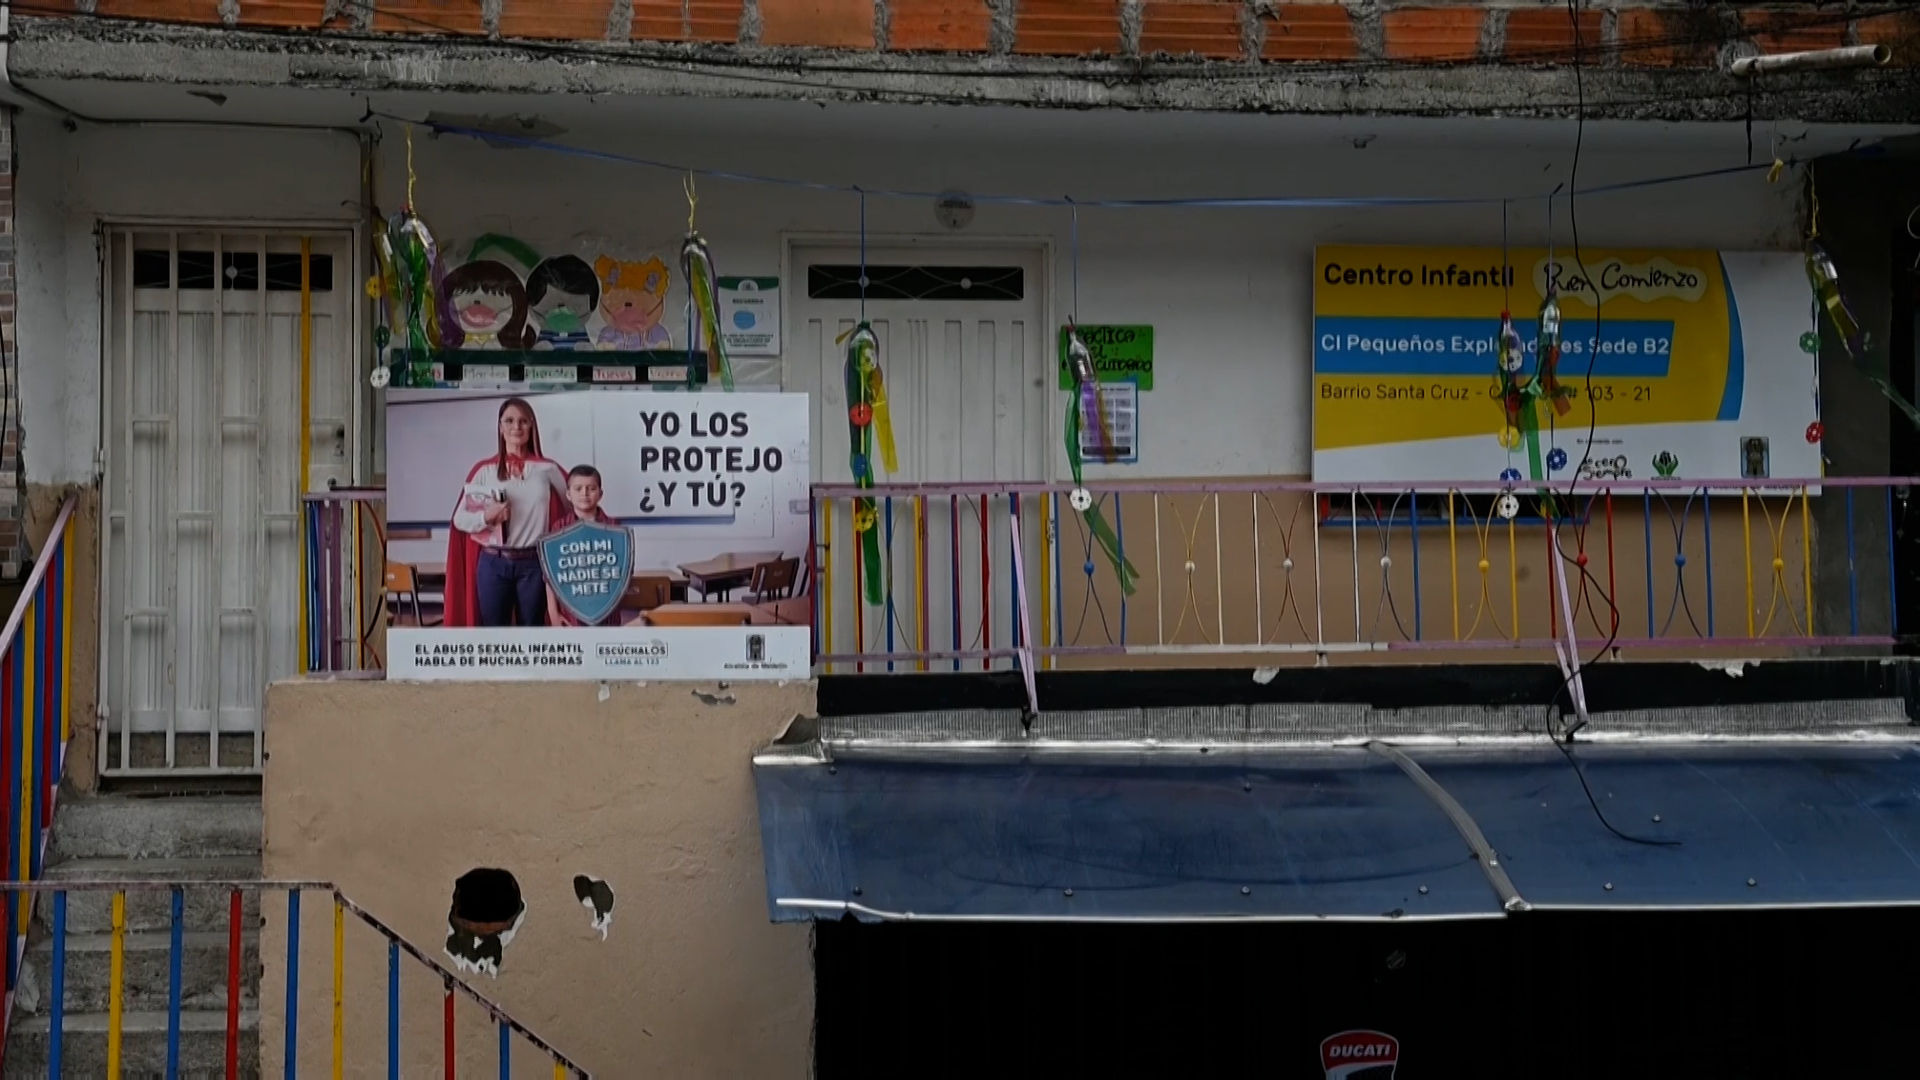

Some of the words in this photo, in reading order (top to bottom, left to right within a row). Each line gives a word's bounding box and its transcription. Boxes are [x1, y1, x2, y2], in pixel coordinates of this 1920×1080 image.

[1324, 263, 1413, 285] Centro
[1421, 263, 1514, 287] Infantil
[1601, 263, 1698, 290] Comienzo
[1321, 334, 1341, 352] CI
[1347, 334, 1445, 356] Pequeños
[1589, 336, 1637, 354] Sede
[1644, 337, 1669, 355] B2
[1321, 383, 1371, 400] Barrio
[1376, 383, 1425, 400] Santa
[1431, 384, 1469, 401] Cruz
[1633, 386, 1651, 401] 21
[639, 411, 680, 437] YO
[690, 411, 749, 437] LOS
[641, 446, 783, 472] PROTEJO
[639, 481, 677, 513] ¿Y
[686, 472, 746, 507] TÚ?
[560, 540, 590, 555] CON
[594, 538, 612, 552] MI
[558, 552, 617, 569] CUERPO
[557, 568, 600, 584] NADIE
[602, 565, 620, 580] SE
[571, 581, 609, 596] METE
[415, 644, 430, 655] EL
[433, 644, 474, 655] ABUSO
[477, 644, 525, 655] SEXUAL
[528, 643, 584, 655] INFANTIL
[599, 643, 666, 656] ESCÚCHALOS
[415, 656, 456, 667] HABLA
[460, 656, 475, 667] DE
[479, 656, 530, 667] MUCHAS
[533, 656, 583, 666] FORMAS
[604, 657, 632, 665] LLAMA
[1329, 1044, 1391, 1058] DUCATI
